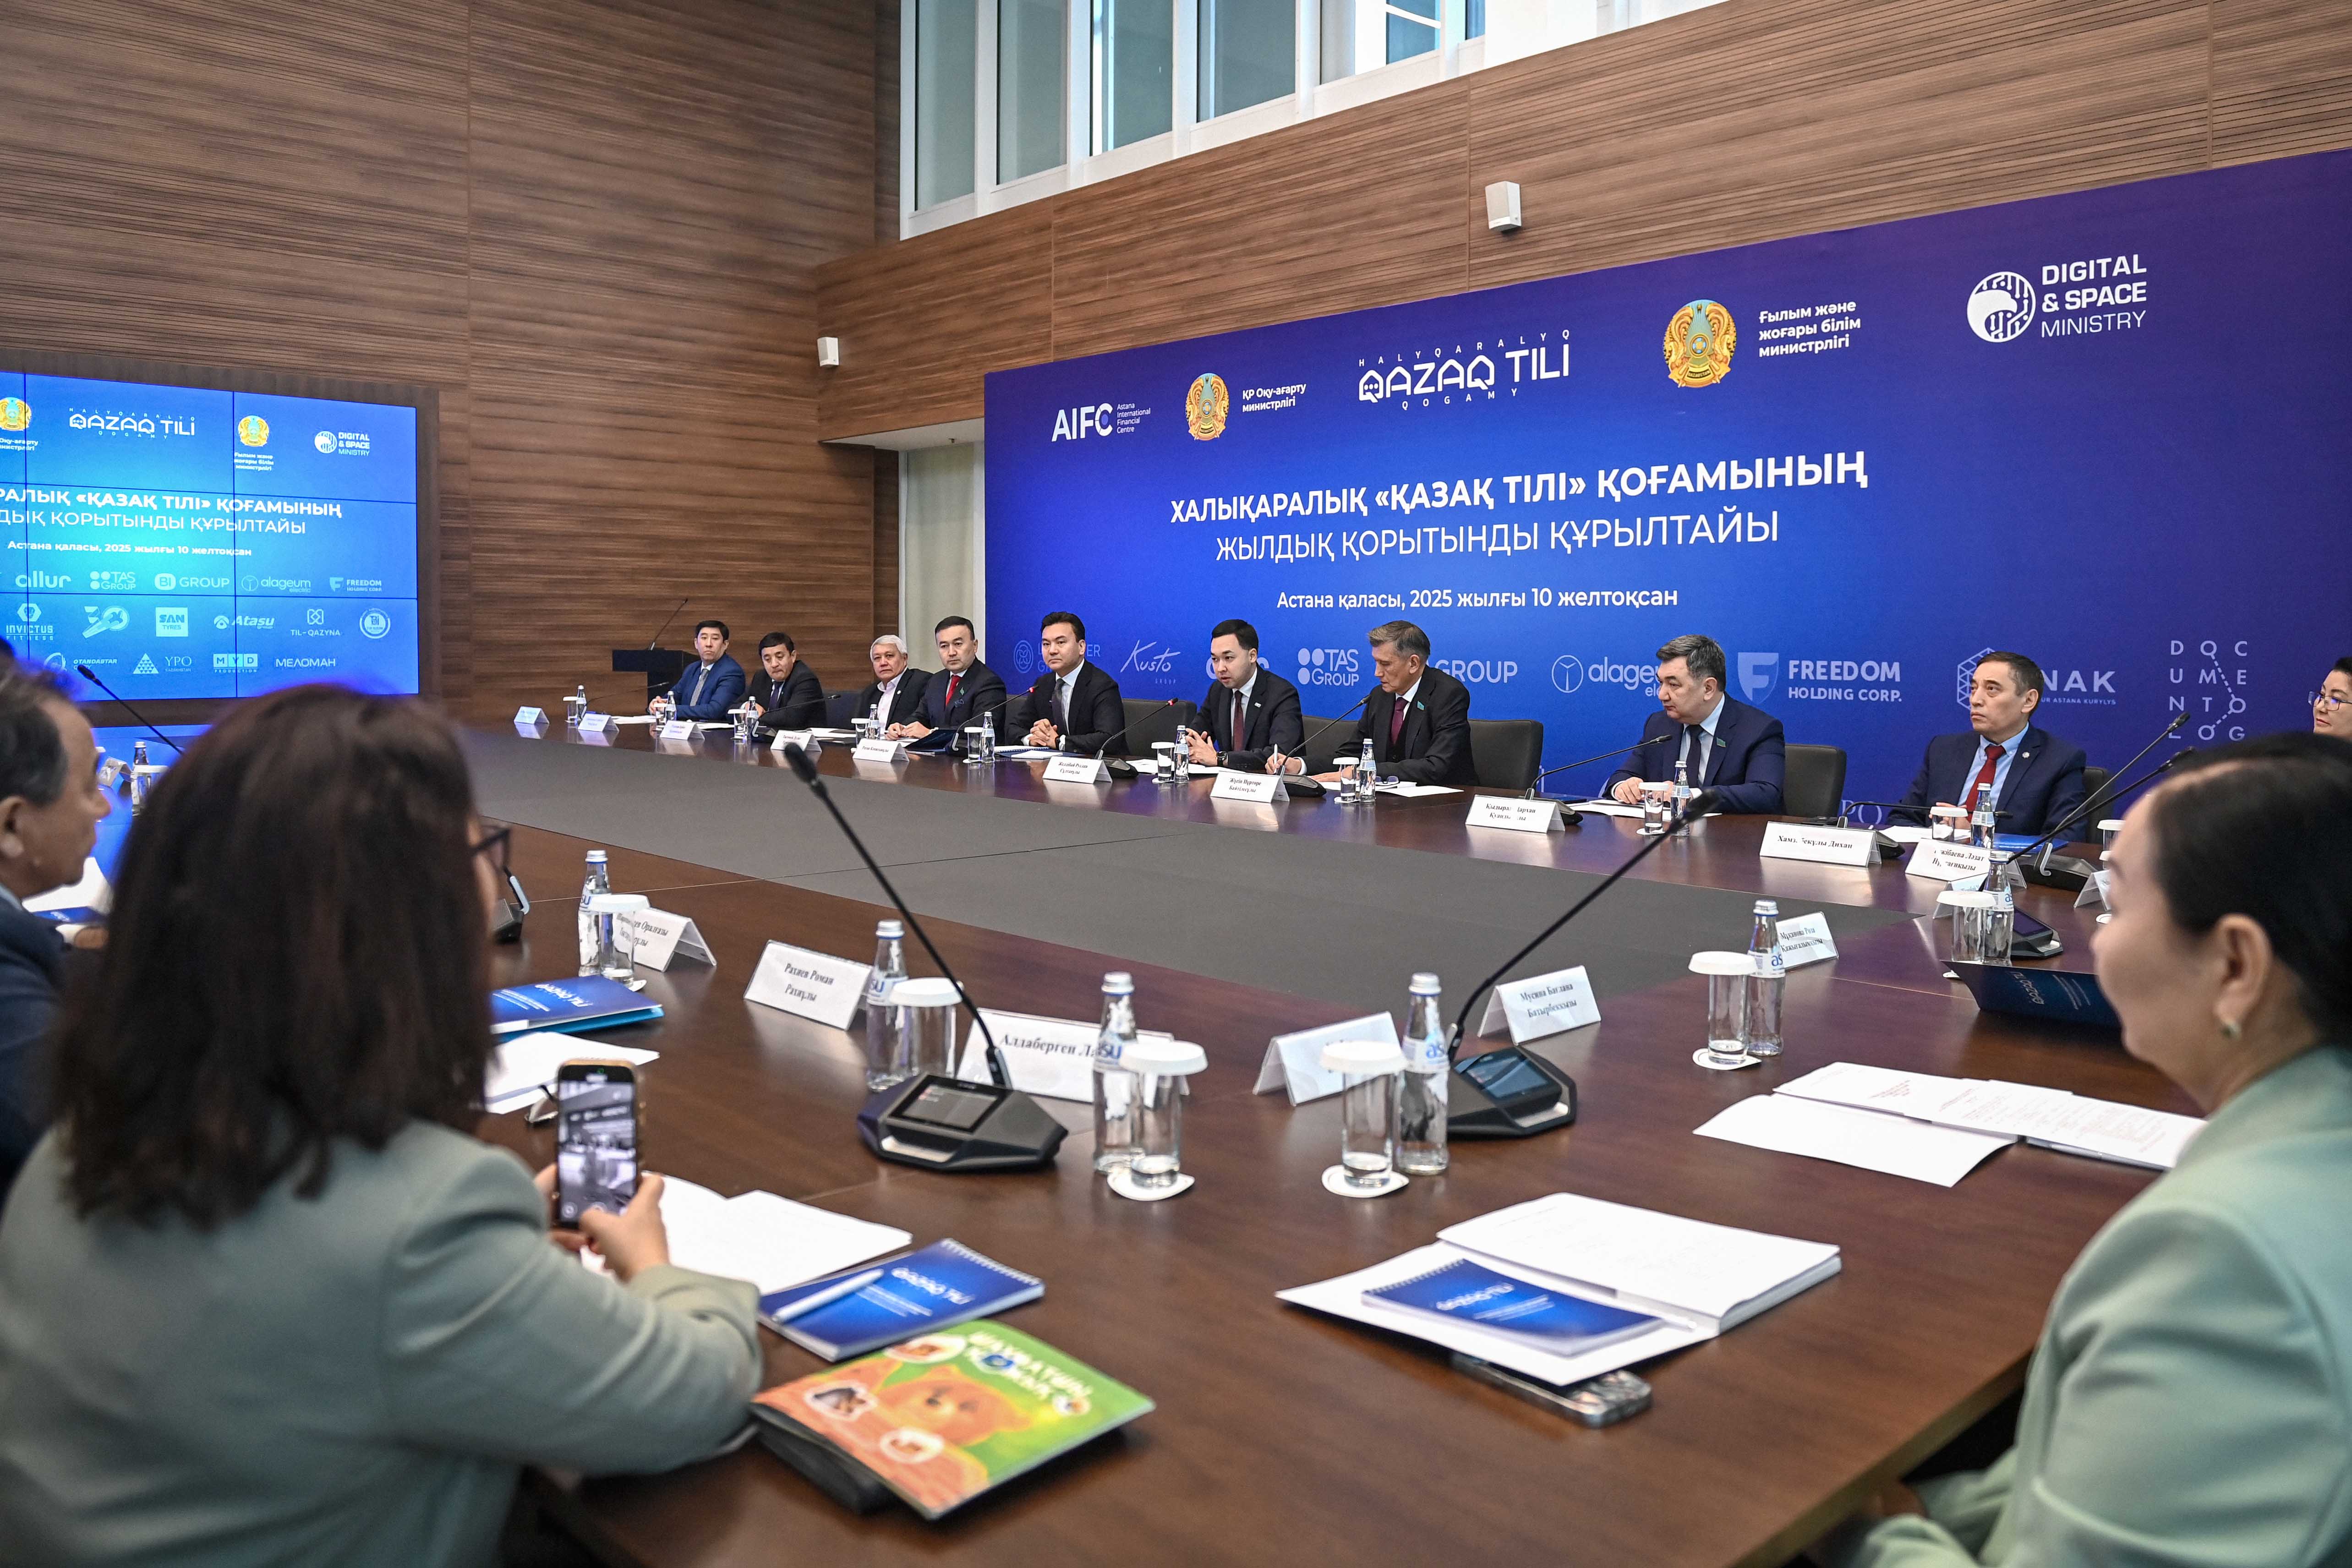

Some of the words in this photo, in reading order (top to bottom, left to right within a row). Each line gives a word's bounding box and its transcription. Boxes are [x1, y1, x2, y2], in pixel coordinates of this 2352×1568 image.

[2042, 254, 2146, 285] DIGITAL
[2042, 293, 2059, 312] &
[2065, 282, 2146, 310] SPACE
[1759, 307, 1811, 323] Ғылым
[1815, 302, 1856, 316] және
[1759, 324, 1816, 340] жоғары
[1821, 317, 1860, 332] білім
[2042, 311, 2146, 337] MINISTRY
[1359, 329, 1570, 366] HALYQARALYQ
[1759, 334, 1849, 357] министрлігі
[1359, 354, 1494, 404] QAZAQ
[1243, 389, 1254, 400] ҚР
[1257, 384, 1306, 398] Оқу-ағарту
[1402, 388, 1517, 410] QOGAMY
[1117, 408, 1150, 418] International
[1243, 396, 1295, 412] министрлігі
[70, 414, 155, 434] QAZAQ
[1052, 403, 1113, 442] AIFC
[1117, 417, 1140, 426] Financial
[339, 432, 370, 441] DIGITAL
[1171, 487, 1367, 522] ХАЛЫҚАРАЛЫҚ
[1375, 478, 1494, 514] «ҚАЗАҚ
[1503, 473, 1586, 503] ТІЛІ»
[1598, 451, 1868, 502] ҚОҒАМЫНЫҢ
[0, 488, 71, 506] РАЛЫҚ
[76, 492, 157, 510] «ҚАЗАҚ
[163, 496, 211, 509] ТІЛІ»
[217, 498, 342, 518] ҚОҒАМЫНЫҢ
[0, 509, 46, 526] ДЫҚ
[51, 512, 183, 531] ҚОРЫТЫНДЫ
[191, 517, 306, 534] ҚҰРЫЛТАЙЫ
[1216, 533, 1334, 563] ЖЫЛДЫҚ
[1343, 523, 1537, 561] ҚОРЫТЫНДЫ
[1551, 506, 1777, 554] ҚҰРЫЛТАЙЫ
[7, 541, 52, 550] Астана
[55, 543, 102, 552] қаласы,
[104, 544, 131, 552] 2025
[134, 546, 175, 554] жылғы
[192, 546, 252, 556] желтоқсан
[15, 571, 71, 588] allur
[101, 582, 136, 590] GROUP
[109, 571, 136, 583] TAS
[159, 577, 172, 587] BI
[179, 578, 230, 588] GROUP
[261, 576, 311, 590] alageum
[1277, 592, 1333, 607] Астана
[1339, 594, 1405, 610] қаласы,
[1410, 590, 1452, 607] 2025
[1457, 593, 1525, 606] жылғы
[1532, 588, 1552, 606] 10
[1558, 590, 1677, 608] желтоқсан
[159, 614, 185, 623] SAN
[231, 615, 275, 627] Atasu
[6, 625, 53, 634] INVICTUS
[165, 656, 191, 667] YPO
[1120, 639, 1181, 672] Kusto
[1324, 649, 1358, 672] TAS
[1312, 668, 1359, 686] GROUP
[1435, 660, 1517, 683] GROUP
[1588, 656, 1660, 690] alage
[1789, 660, 1900, 682] FREEDOM
[1789, 687, 1854, 700] HOLDING
[1859, 689, 1902, 701] CORP.
[810, 970, 834, 985] Роман
